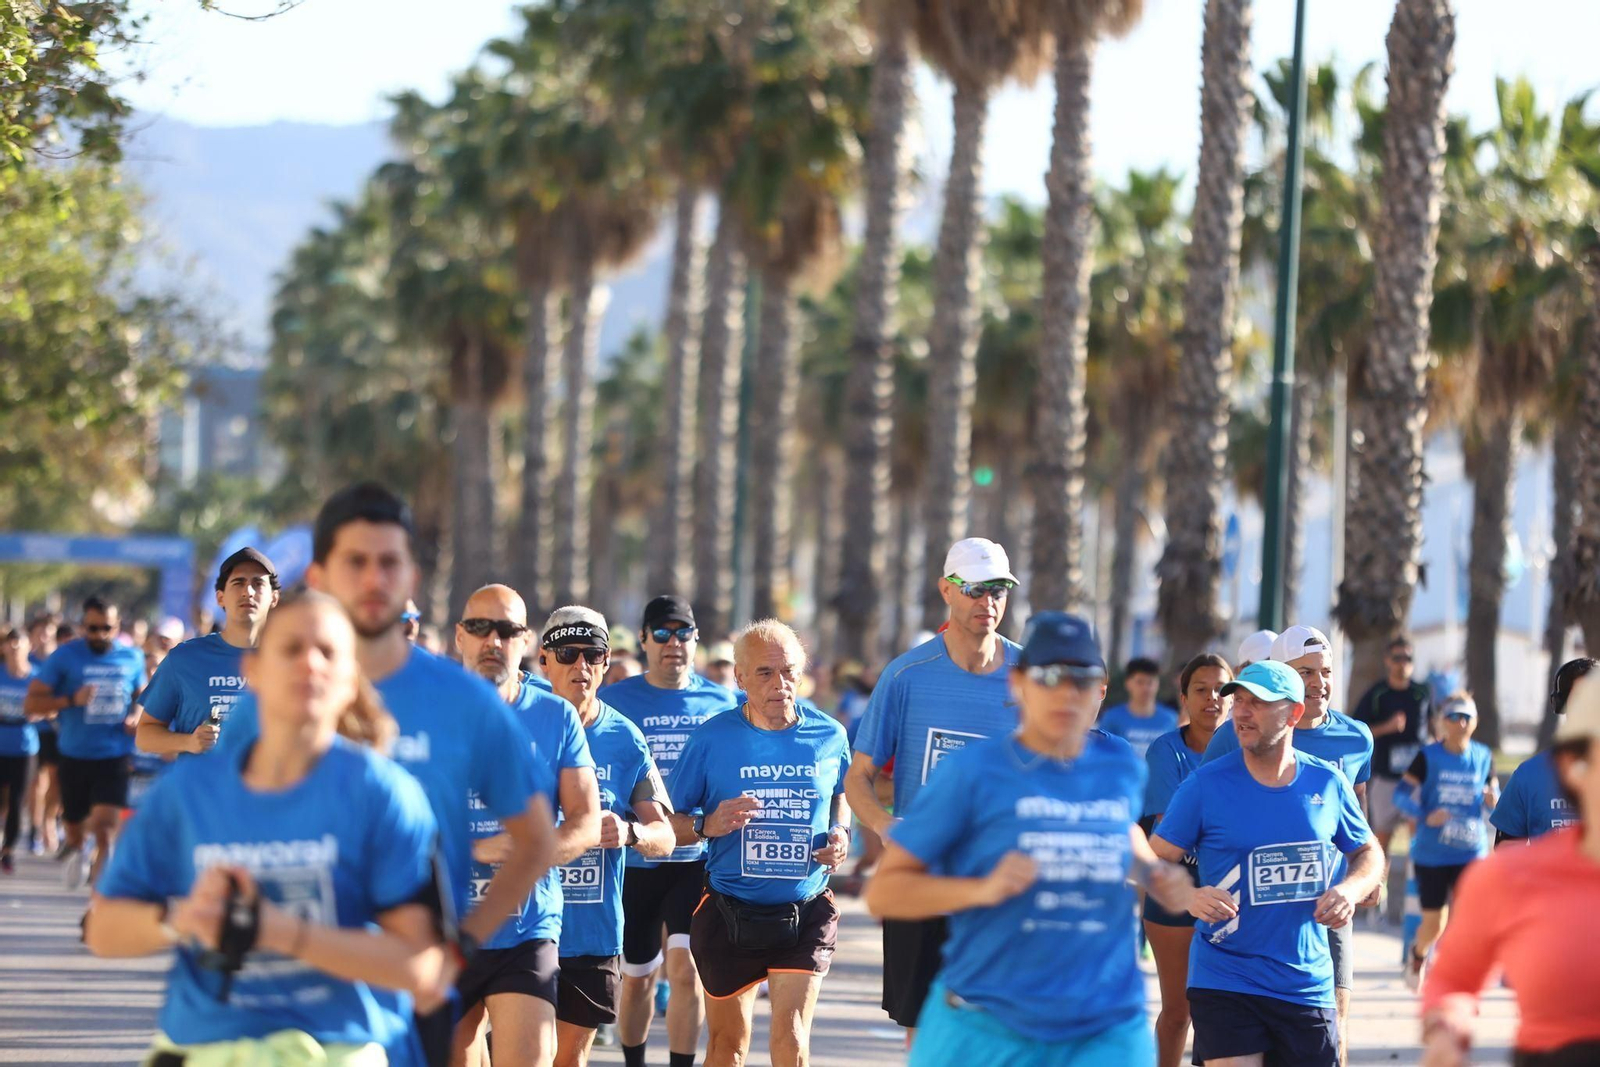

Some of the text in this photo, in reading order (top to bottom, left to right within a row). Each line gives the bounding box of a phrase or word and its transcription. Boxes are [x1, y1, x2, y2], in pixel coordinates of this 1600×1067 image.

[550, 626, 592, 642] TERREX
[208, 675, 247, 690] may
[651, 752, 680, 761] FRIE
[740, 761, 820, 781] mayoral
[754, 828, 776, 836] Carrera
[751, 843, 805, 860] 1888
[1260, 864, 1319, 884] 2174
